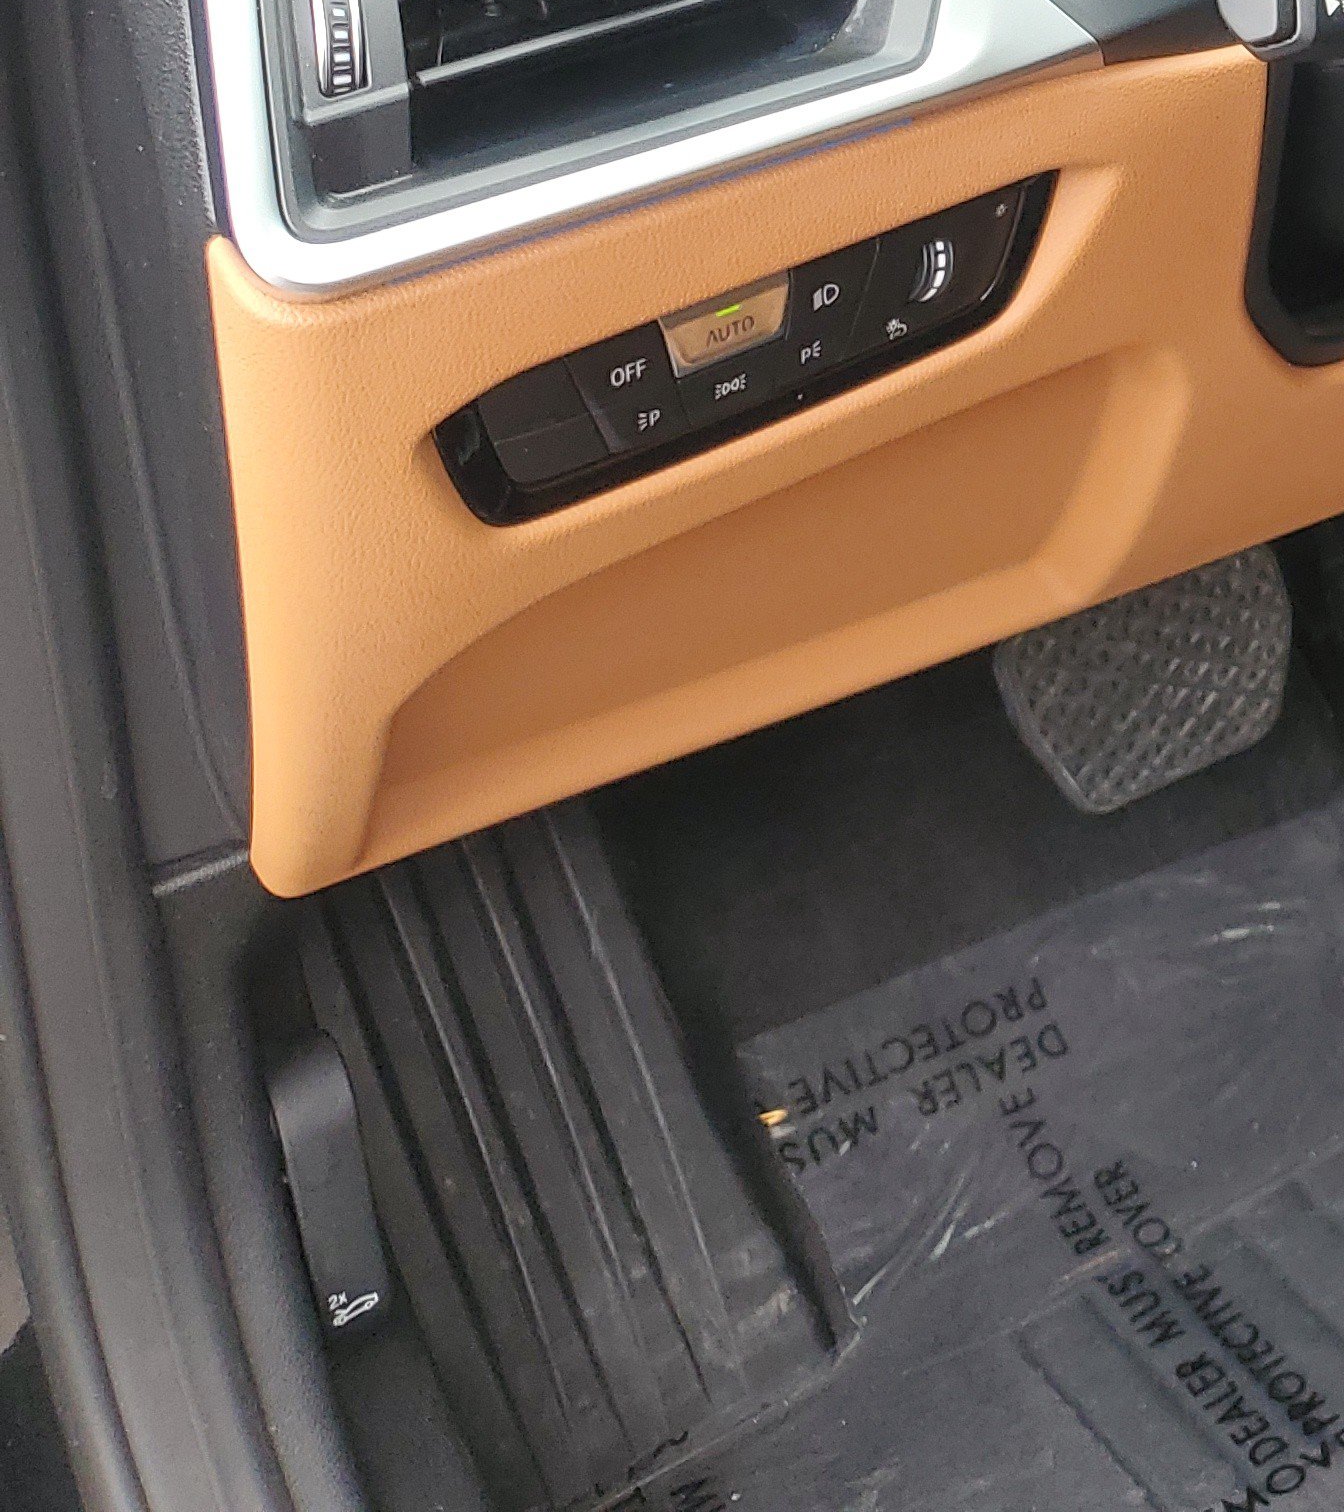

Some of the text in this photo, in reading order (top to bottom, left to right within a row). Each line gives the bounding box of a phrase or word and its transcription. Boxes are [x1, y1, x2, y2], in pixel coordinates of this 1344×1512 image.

[610, 357, 648, 387] OFF
[706, 315, 755, 347] AUTO
[779, 1021, 1069, 1172] DEALER MUS
[788, 976, 1048, 1116] PROTECTIVE
[1000, 1088, 1111, 1254] REMOVE
[1174, 1264, 1342, 1437] PROTECTIVE
[1175, 1351, 1290, 1468] DEALER
